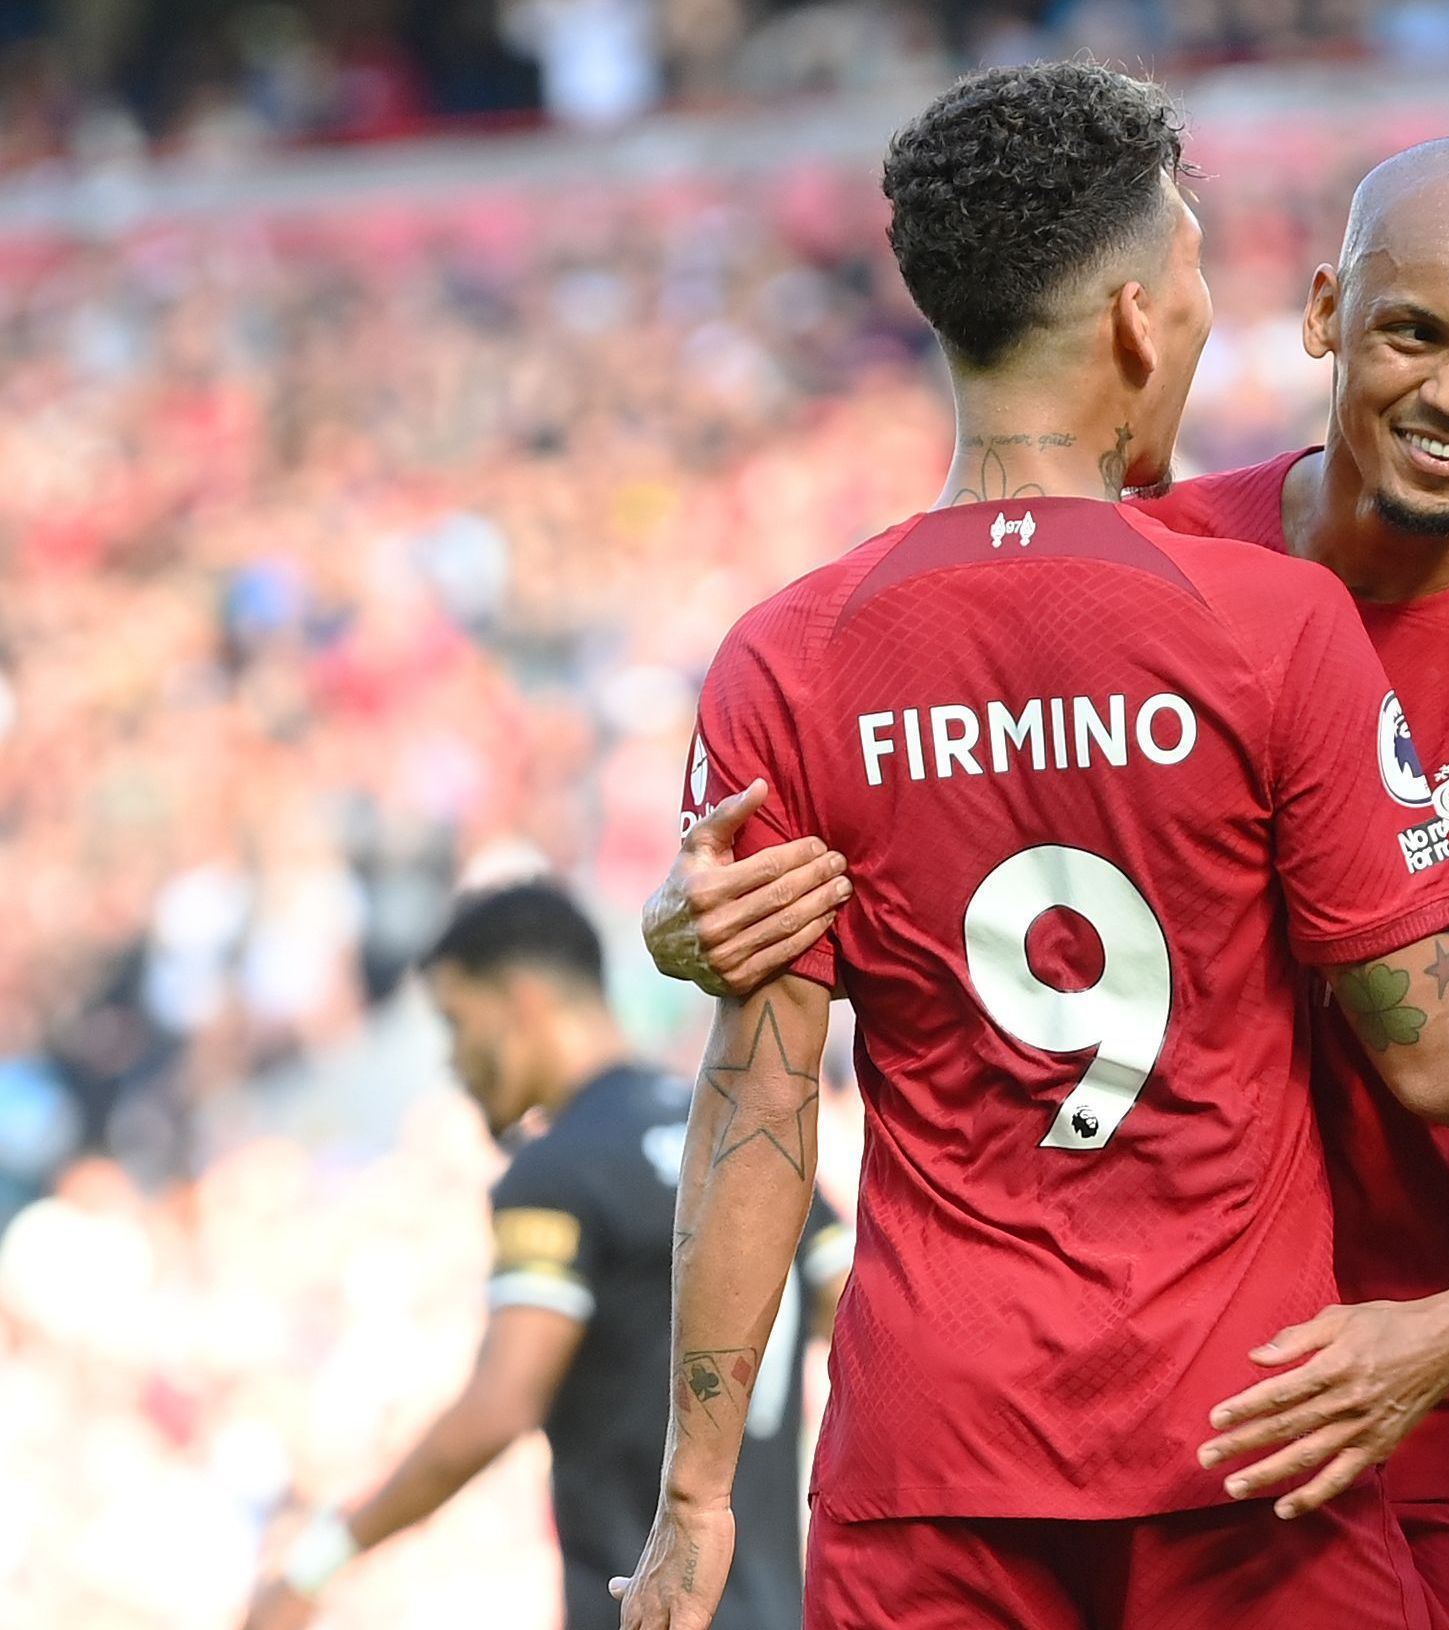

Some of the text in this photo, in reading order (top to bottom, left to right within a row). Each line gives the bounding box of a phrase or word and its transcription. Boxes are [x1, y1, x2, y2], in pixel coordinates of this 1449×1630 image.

[1005, 520, 1023, 534] 97
[858, 692, 1198, 786] FIRMINO
[1397, 828, 1429, 852] No
[963, 843, 1173, 1149] 9
